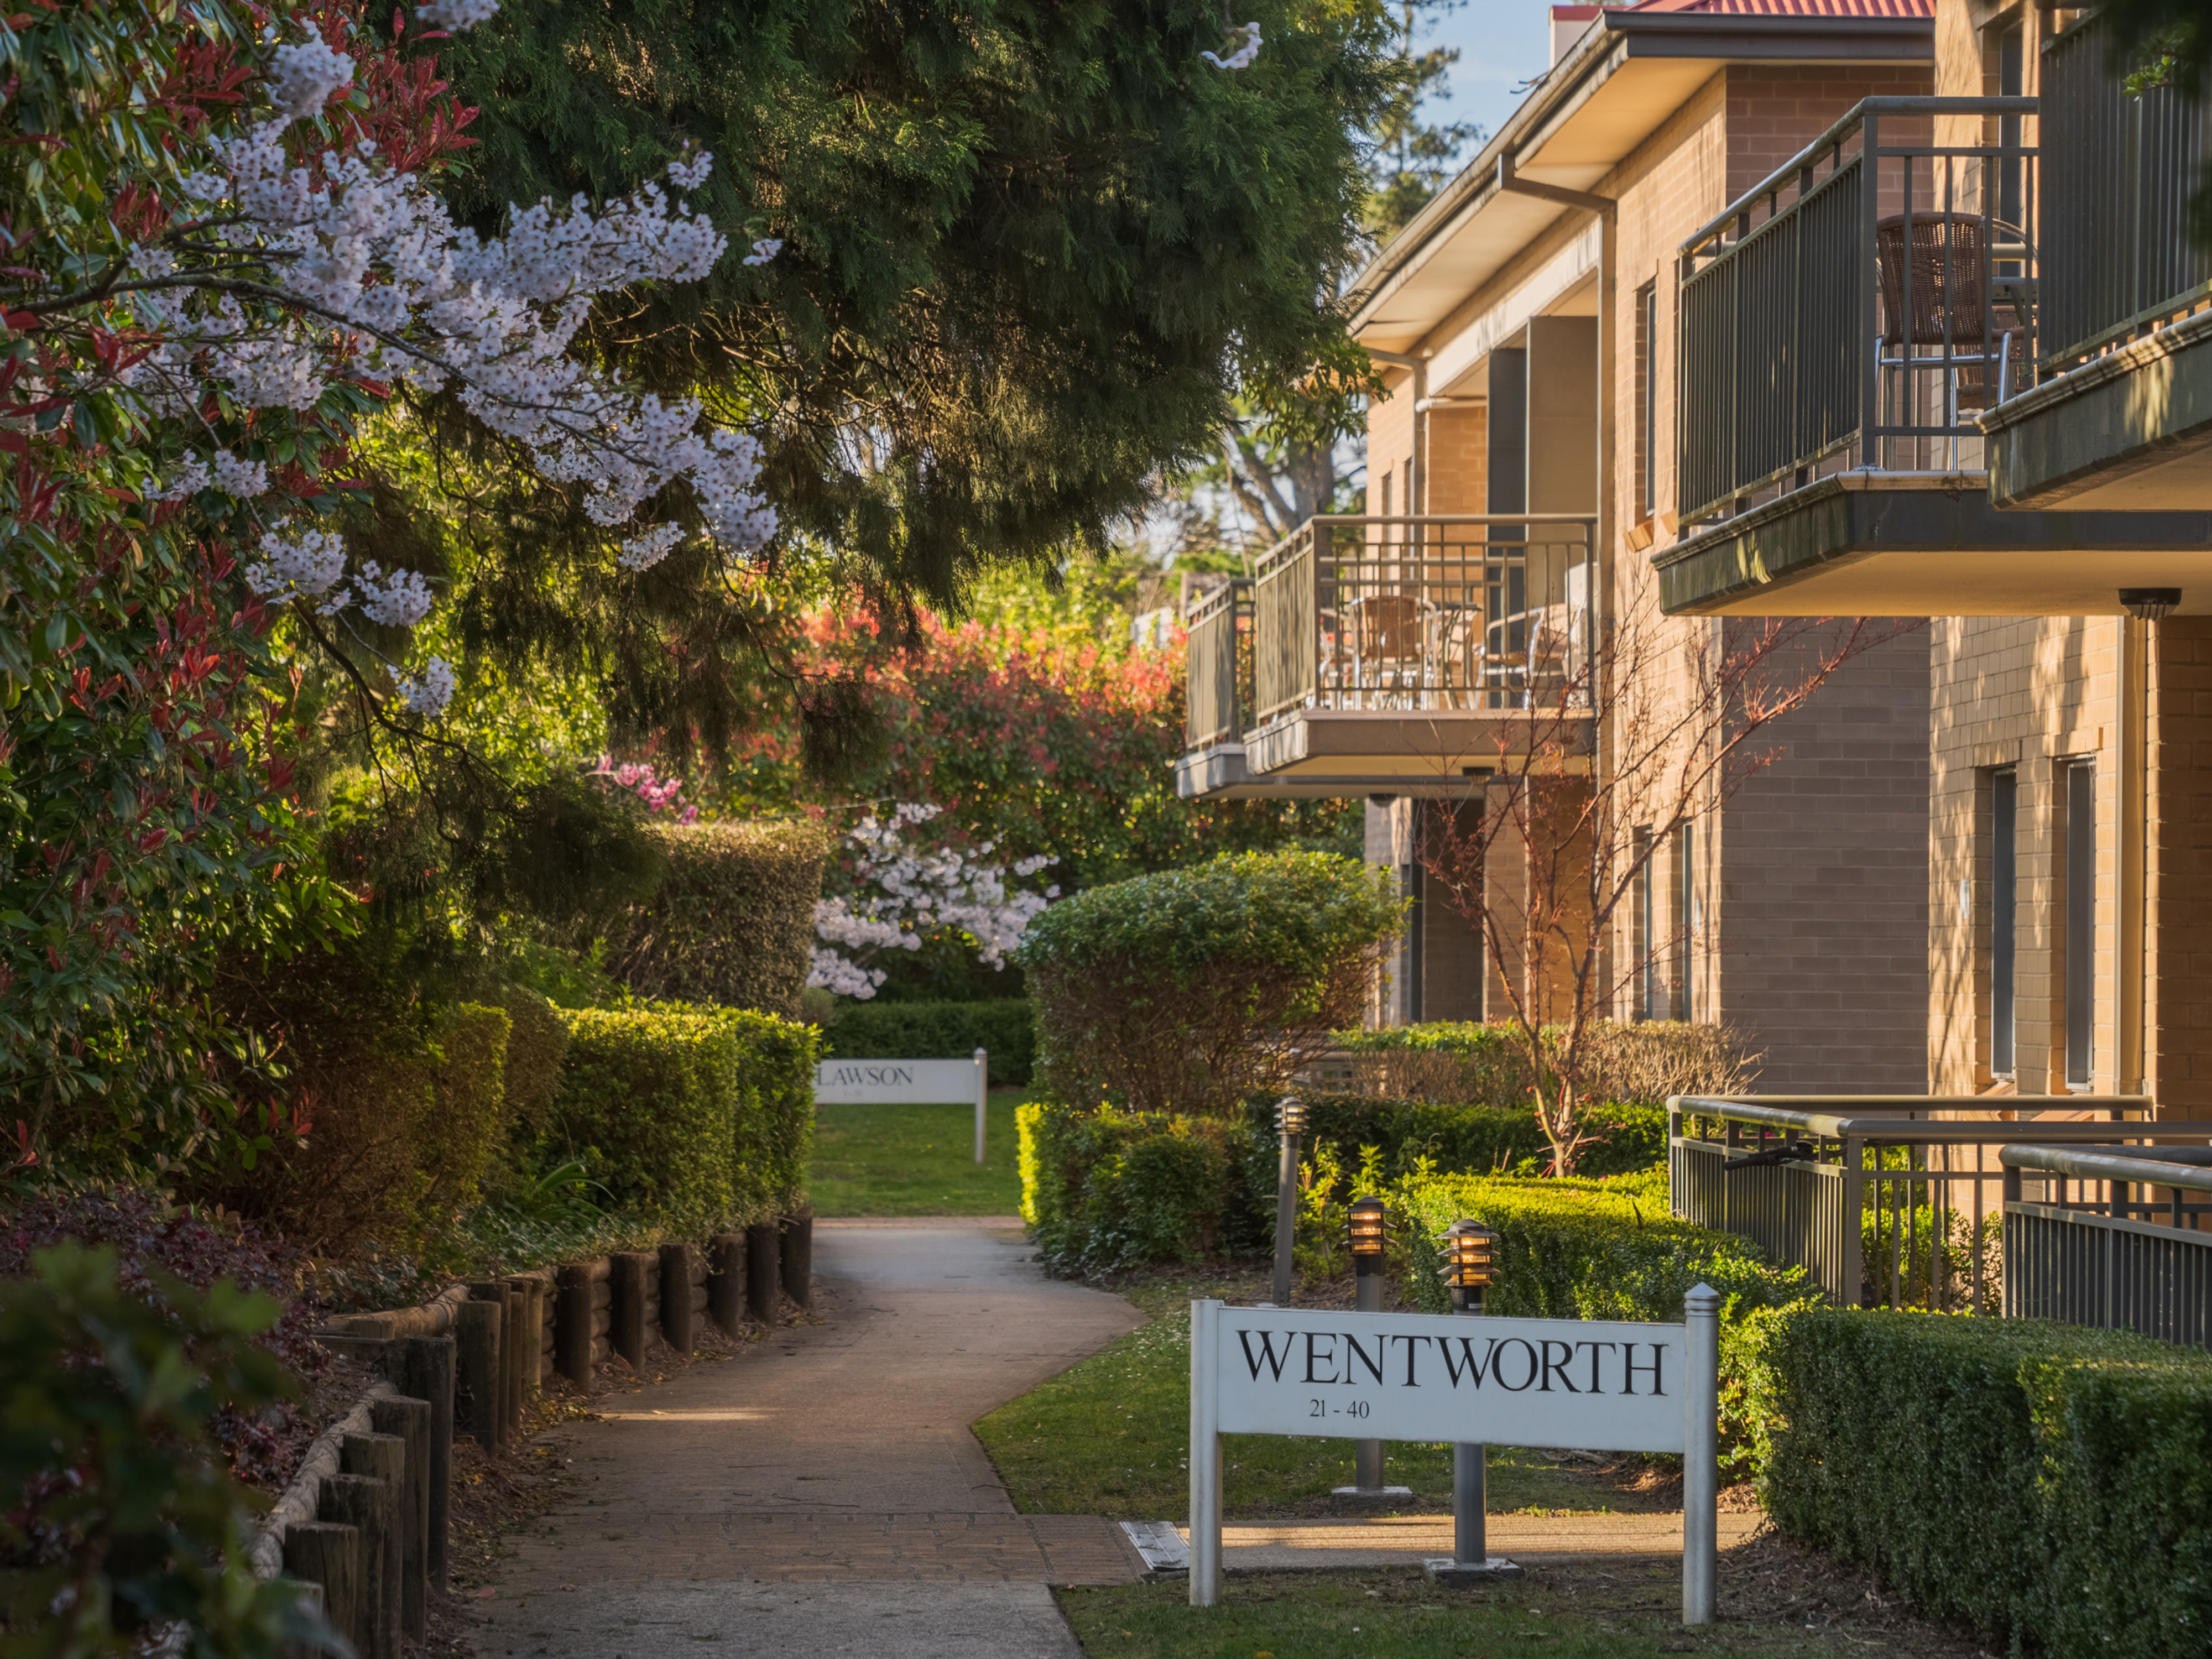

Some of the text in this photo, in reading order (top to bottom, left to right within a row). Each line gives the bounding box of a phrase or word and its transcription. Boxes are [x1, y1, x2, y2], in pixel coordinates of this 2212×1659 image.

[817, 1067, 913, 1086] LAWSON
[1235, 1329, 1668, 1396] WENTWORTH
[1310, 1399, 1326, 1417] 21
[1347, 1400, 1370, 1419] 40
